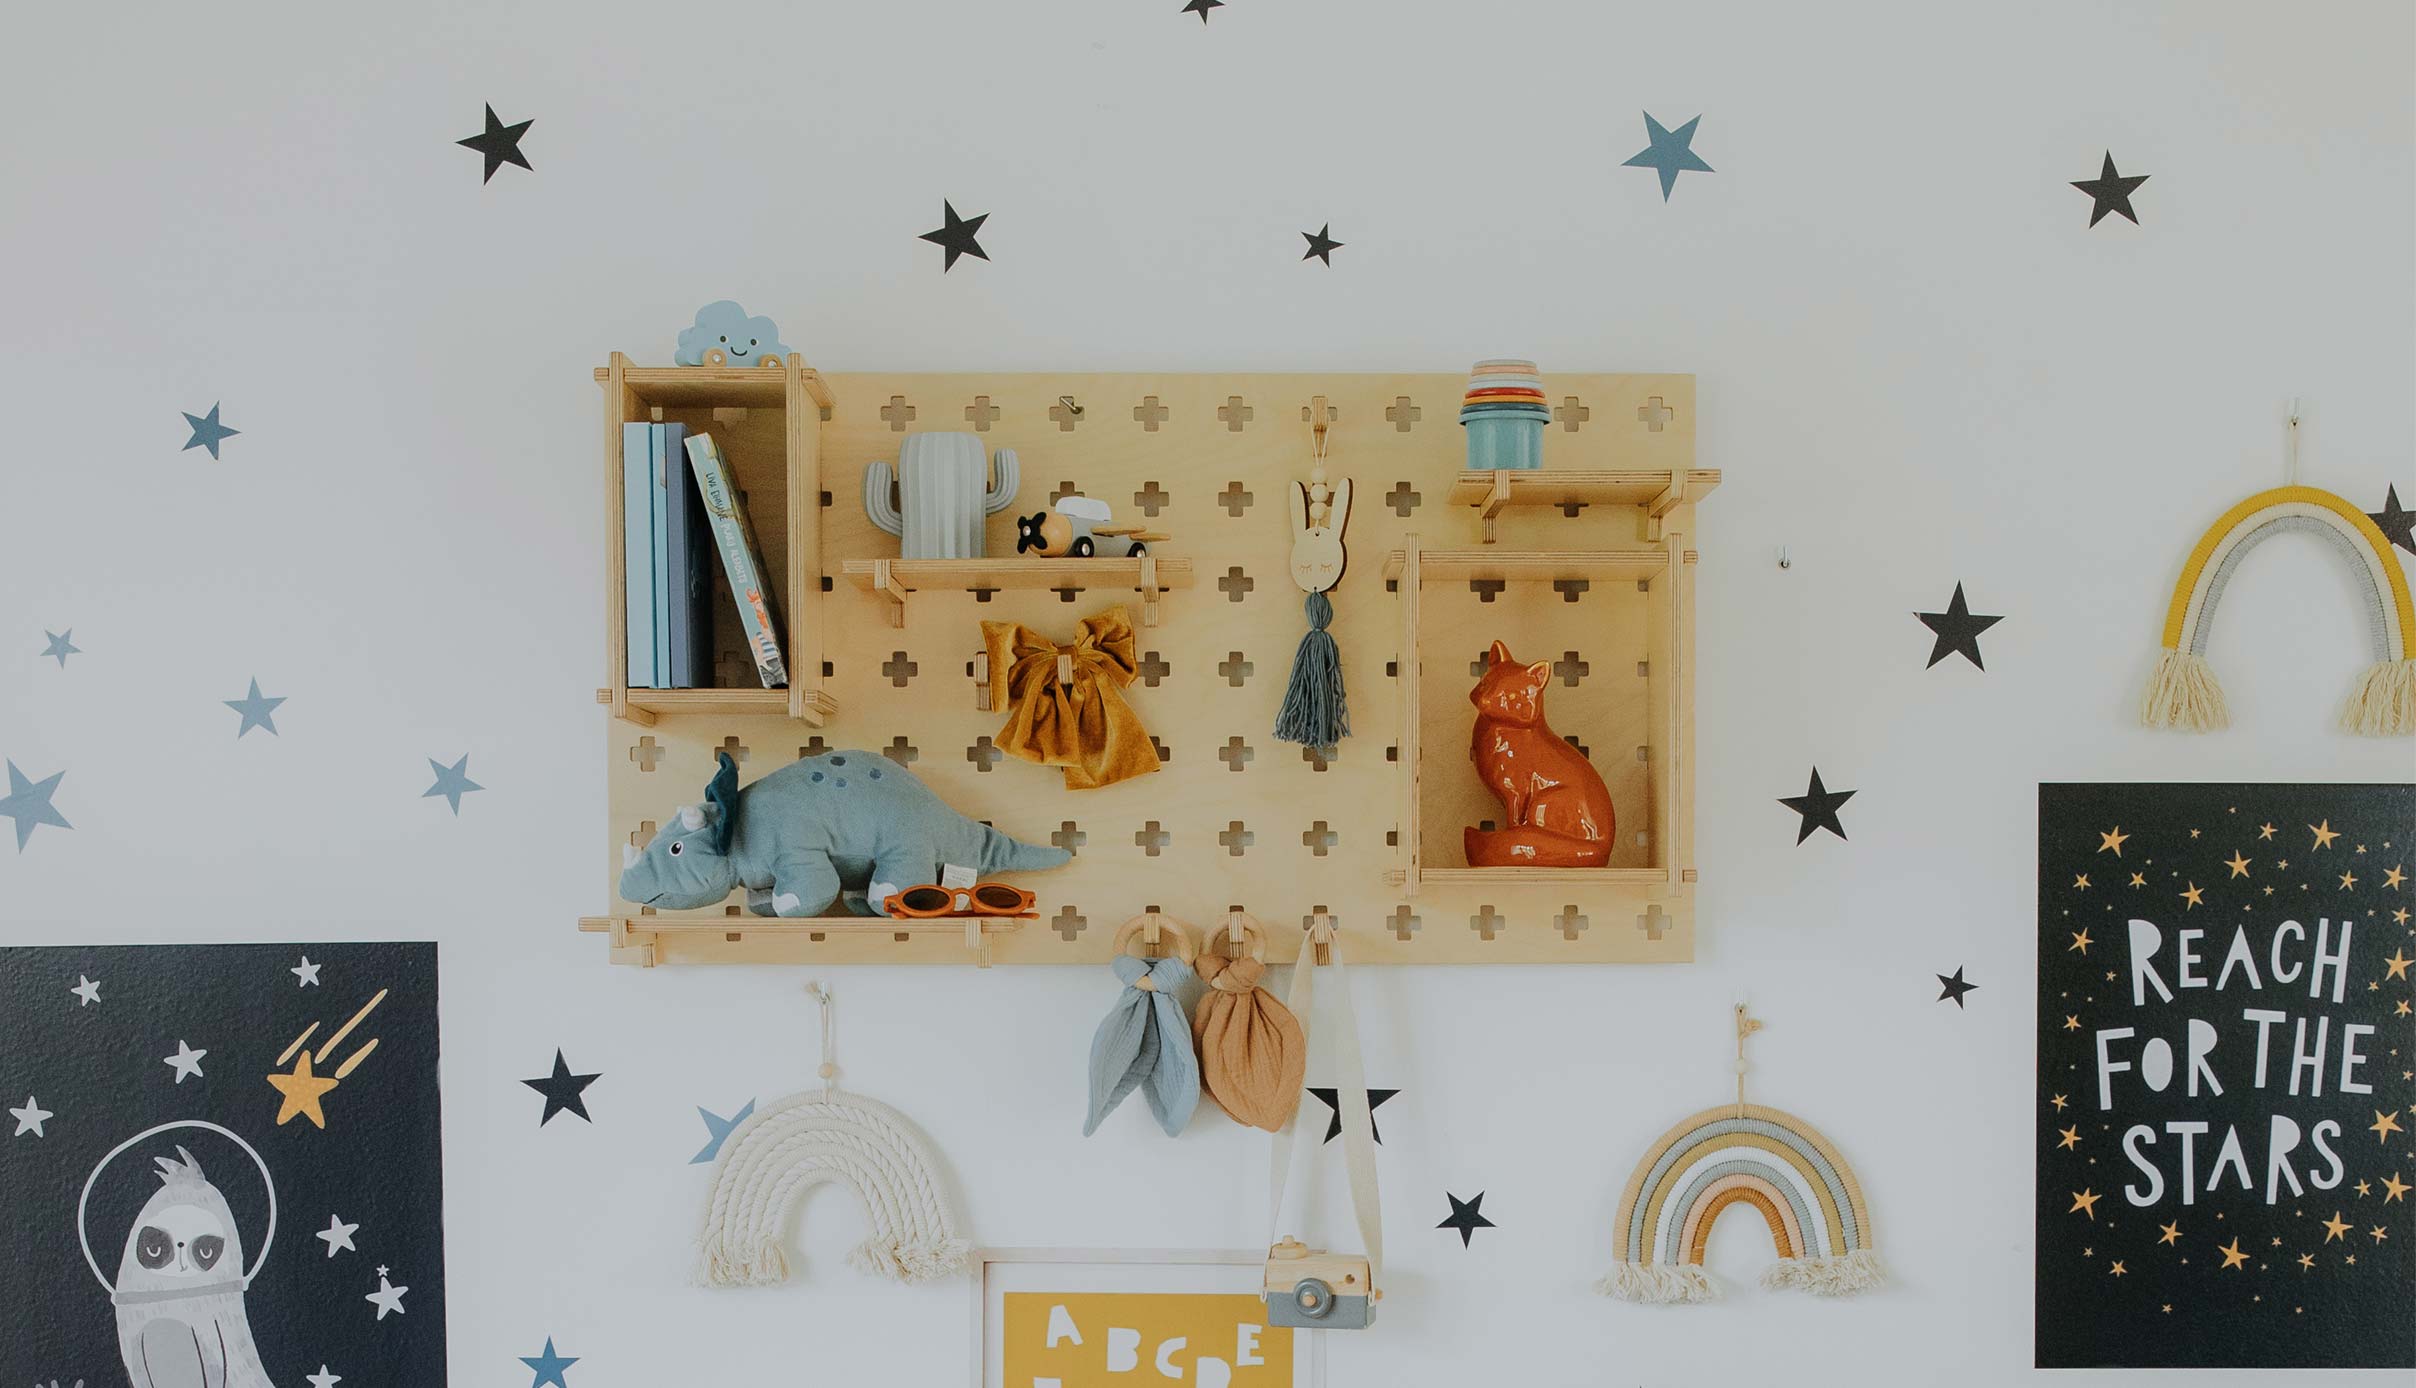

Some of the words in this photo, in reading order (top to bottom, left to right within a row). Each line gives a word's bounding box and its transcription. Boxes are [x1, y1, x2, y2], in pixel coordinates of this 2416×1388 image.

[2128, 918, 2353, 1006] REACH
[2097, 1019, 2224, 1111] FOR
[2244, 1009, 2376, 1098] THE
[2123, 1115, 2344, 1207] STARS
